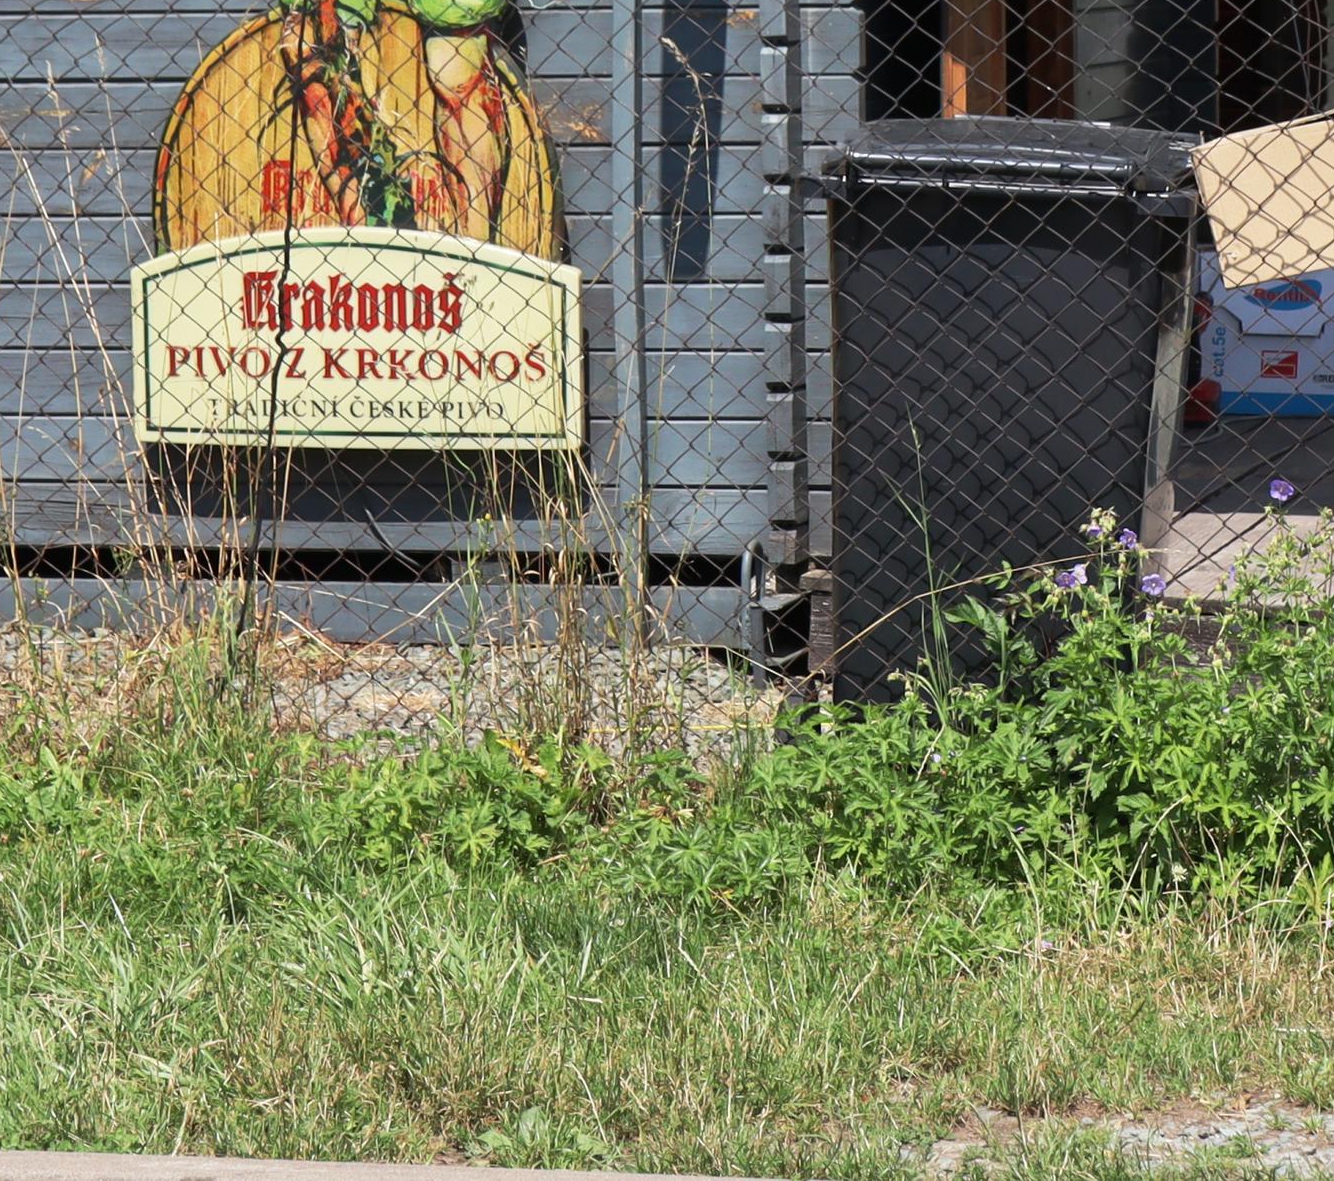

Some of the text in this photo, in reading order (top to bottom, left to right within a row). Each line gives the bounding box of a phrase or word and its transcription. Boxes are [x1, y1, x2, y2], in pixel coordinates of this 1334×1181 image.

[241, 271, 466, 334] Krakonoš
[166, 343, 547, 382] PIVO Z KRKONOŠ
[350, 396, 432, 419] ČESKÉ
[442, 401, 504, 420] PIVO
